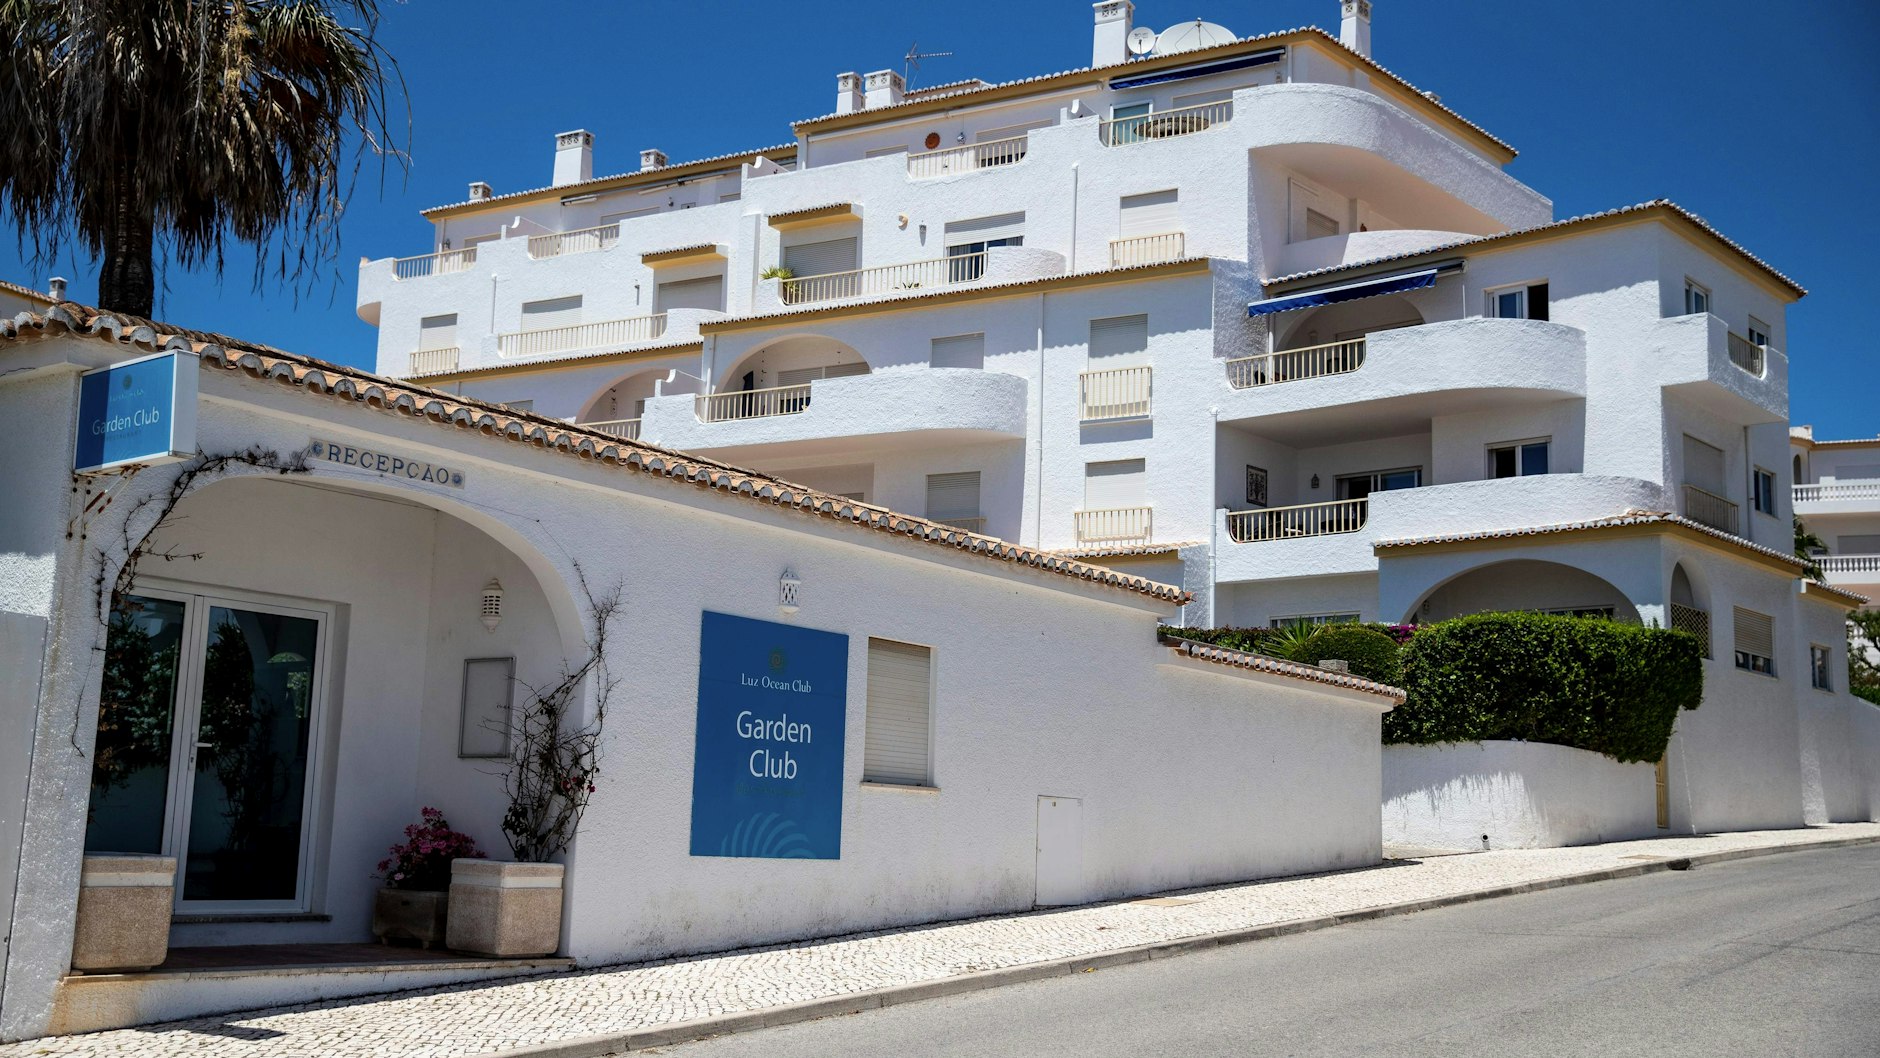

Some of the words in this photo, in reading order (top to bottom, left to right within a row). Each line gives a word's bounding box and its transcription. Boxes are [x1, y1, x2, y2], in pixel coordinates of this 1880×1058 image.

[92, 415, 131, 435] Garden
[133, 406, 160, 427] Club
[741, 672, 759, 687] Luz
[761, 675, 790, 691] Ocean
[792, 679, 812, 693] Club
[736, 710, 812, 744] Garden
[749, 749, 797, 780] Club
